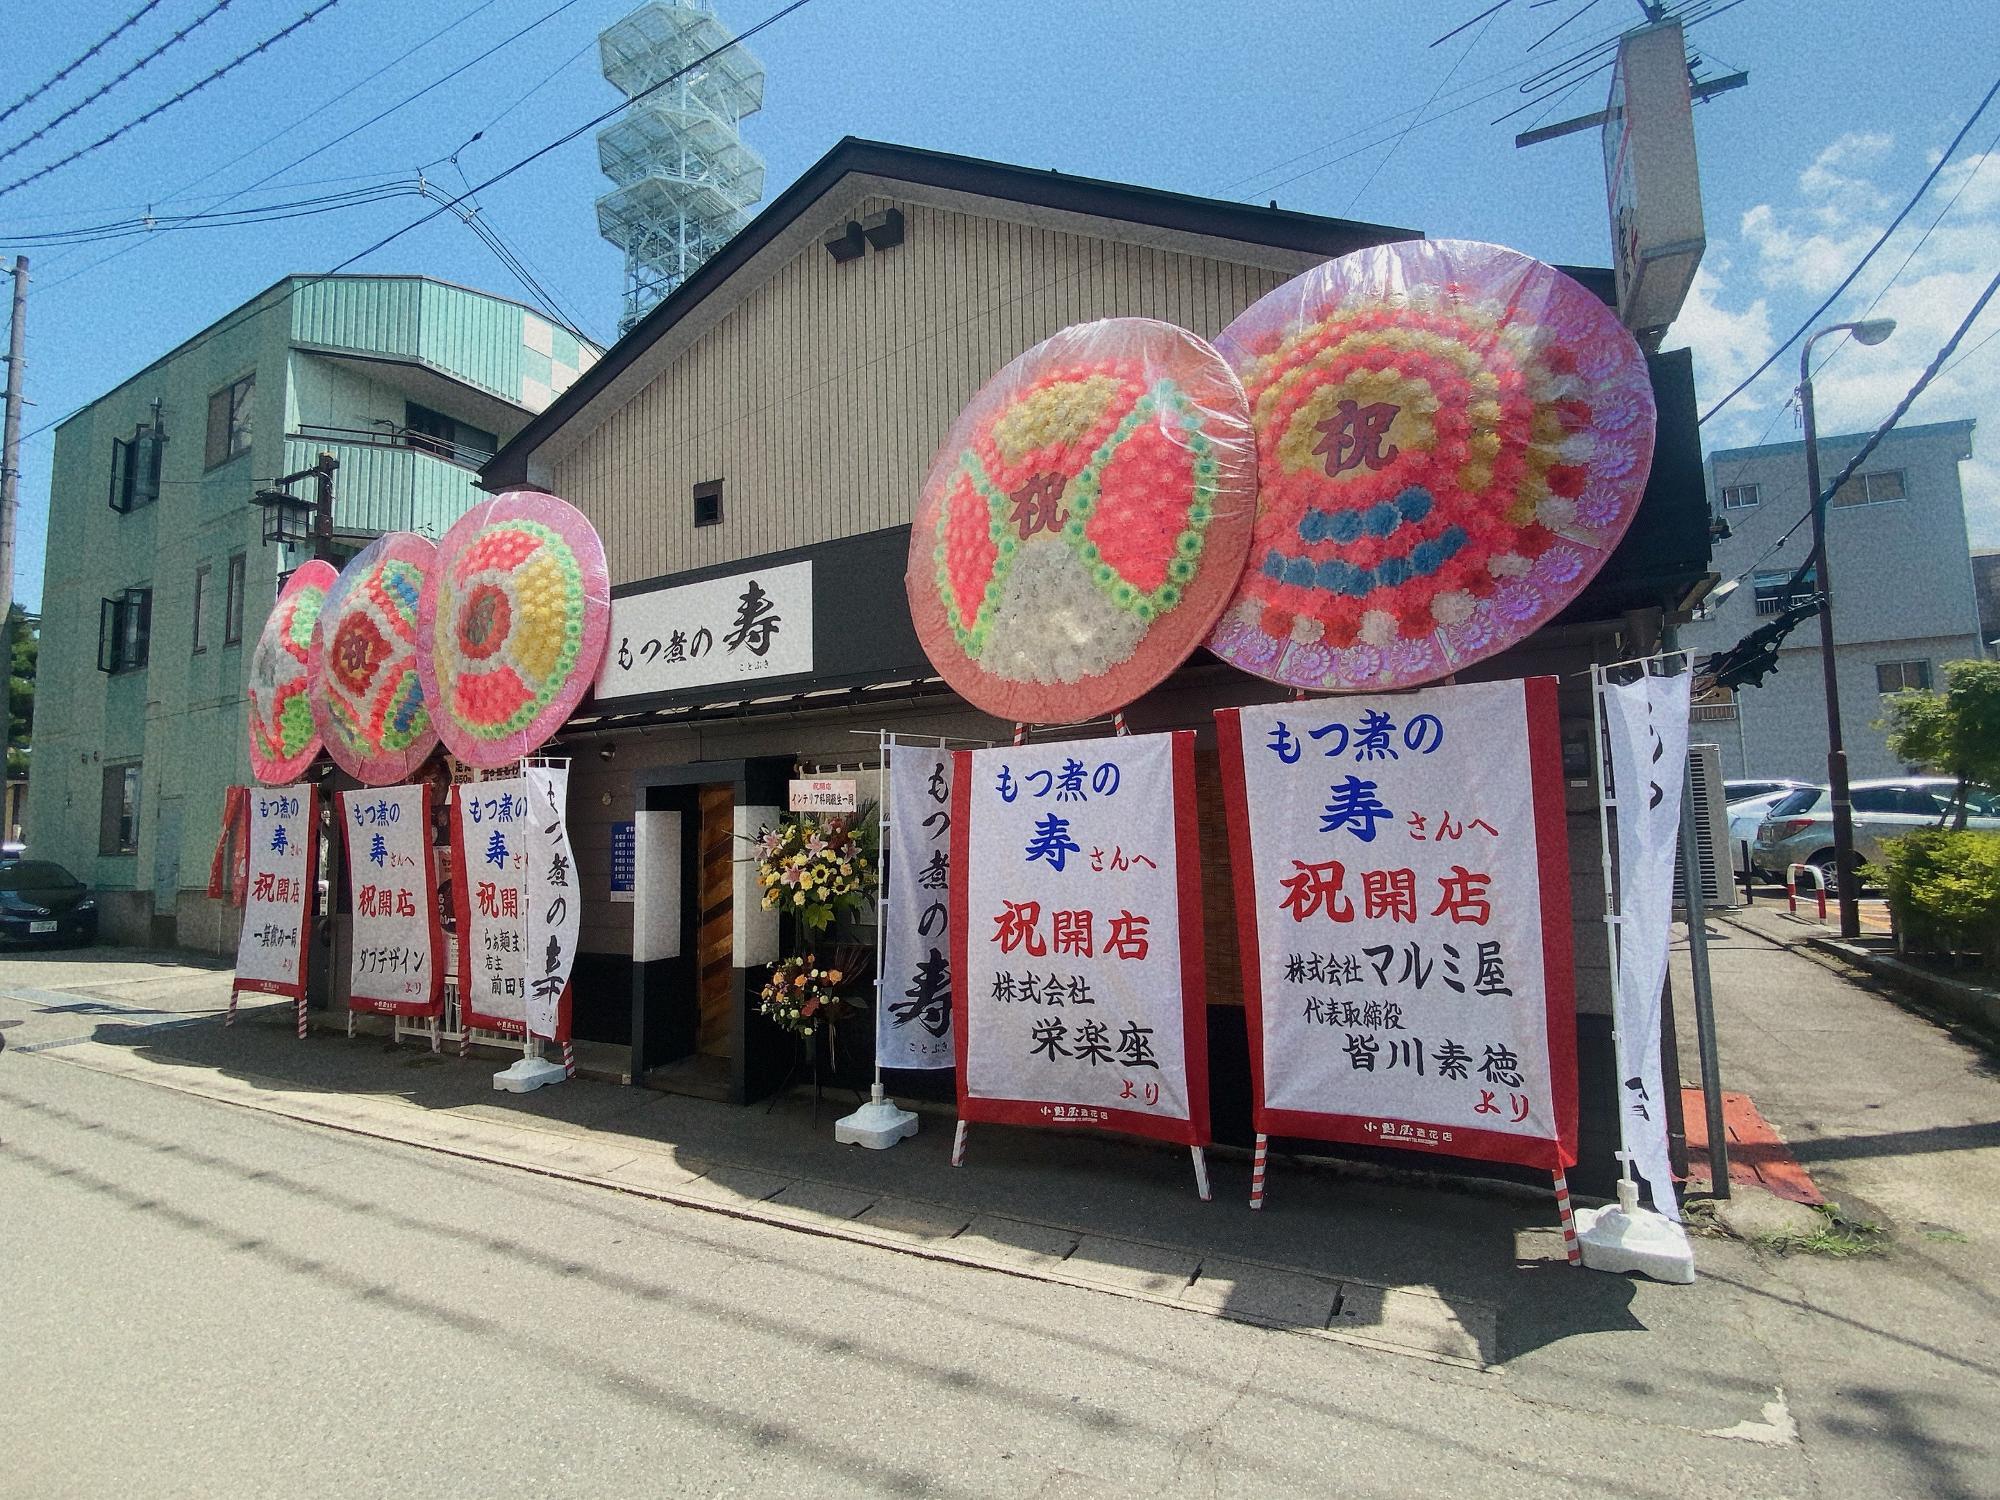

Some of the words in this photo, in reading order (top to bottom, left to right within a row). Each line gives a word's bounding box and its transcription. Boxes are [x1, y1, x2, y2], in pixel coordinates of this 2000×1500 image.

[1311, 399, 1400, 478] 祝
[1009, 471, 1070, 541] 祝
[738, 660, 769, 672] ことぶき
[1266, 708, 1444, 764] もつ煮の
[995, 757, 1121, 803] もつ煮の
[261, 795, 299, 819] もつ煮の
[354, 799, 400, 827] もつ煮の
[469, 793, 528, 824] もつ煮の
[1319, 774, 1394, 843] 寿
[1406, 811, 1500, 842] さんへ
[271, 824, 288, 856] 寿
[369, 832, 389, 868] 寿
[390, 852, 415, 868] さんへ
[485, 830, 510, 870] 寿
[1025, 812, 1081, 873] 寿
[1089, 845, 1157, 872] さんへ
[358, 884, 416, 918] 祝開店
[1278, 860, 1492, 926] 祝開店
[990, 899, 1150, 961] 祝開店
[485, 955, 504, 971] 店主
[1284, 941, 1513, 997] 株式会社マルミ屋
[405, 981, 422, 995] より
[991, 970, 1096, 1007] 株式会社
[1302, 995, 1408, 1031] 代表取締役
[1030, 1016, 1160, 1070] 栄楽座
[1342, 1033, 1525, 1088] 皆川素徳
[1119, 1079, 1160, 1106] より
[1473, 1089, 1530, 1123] より
